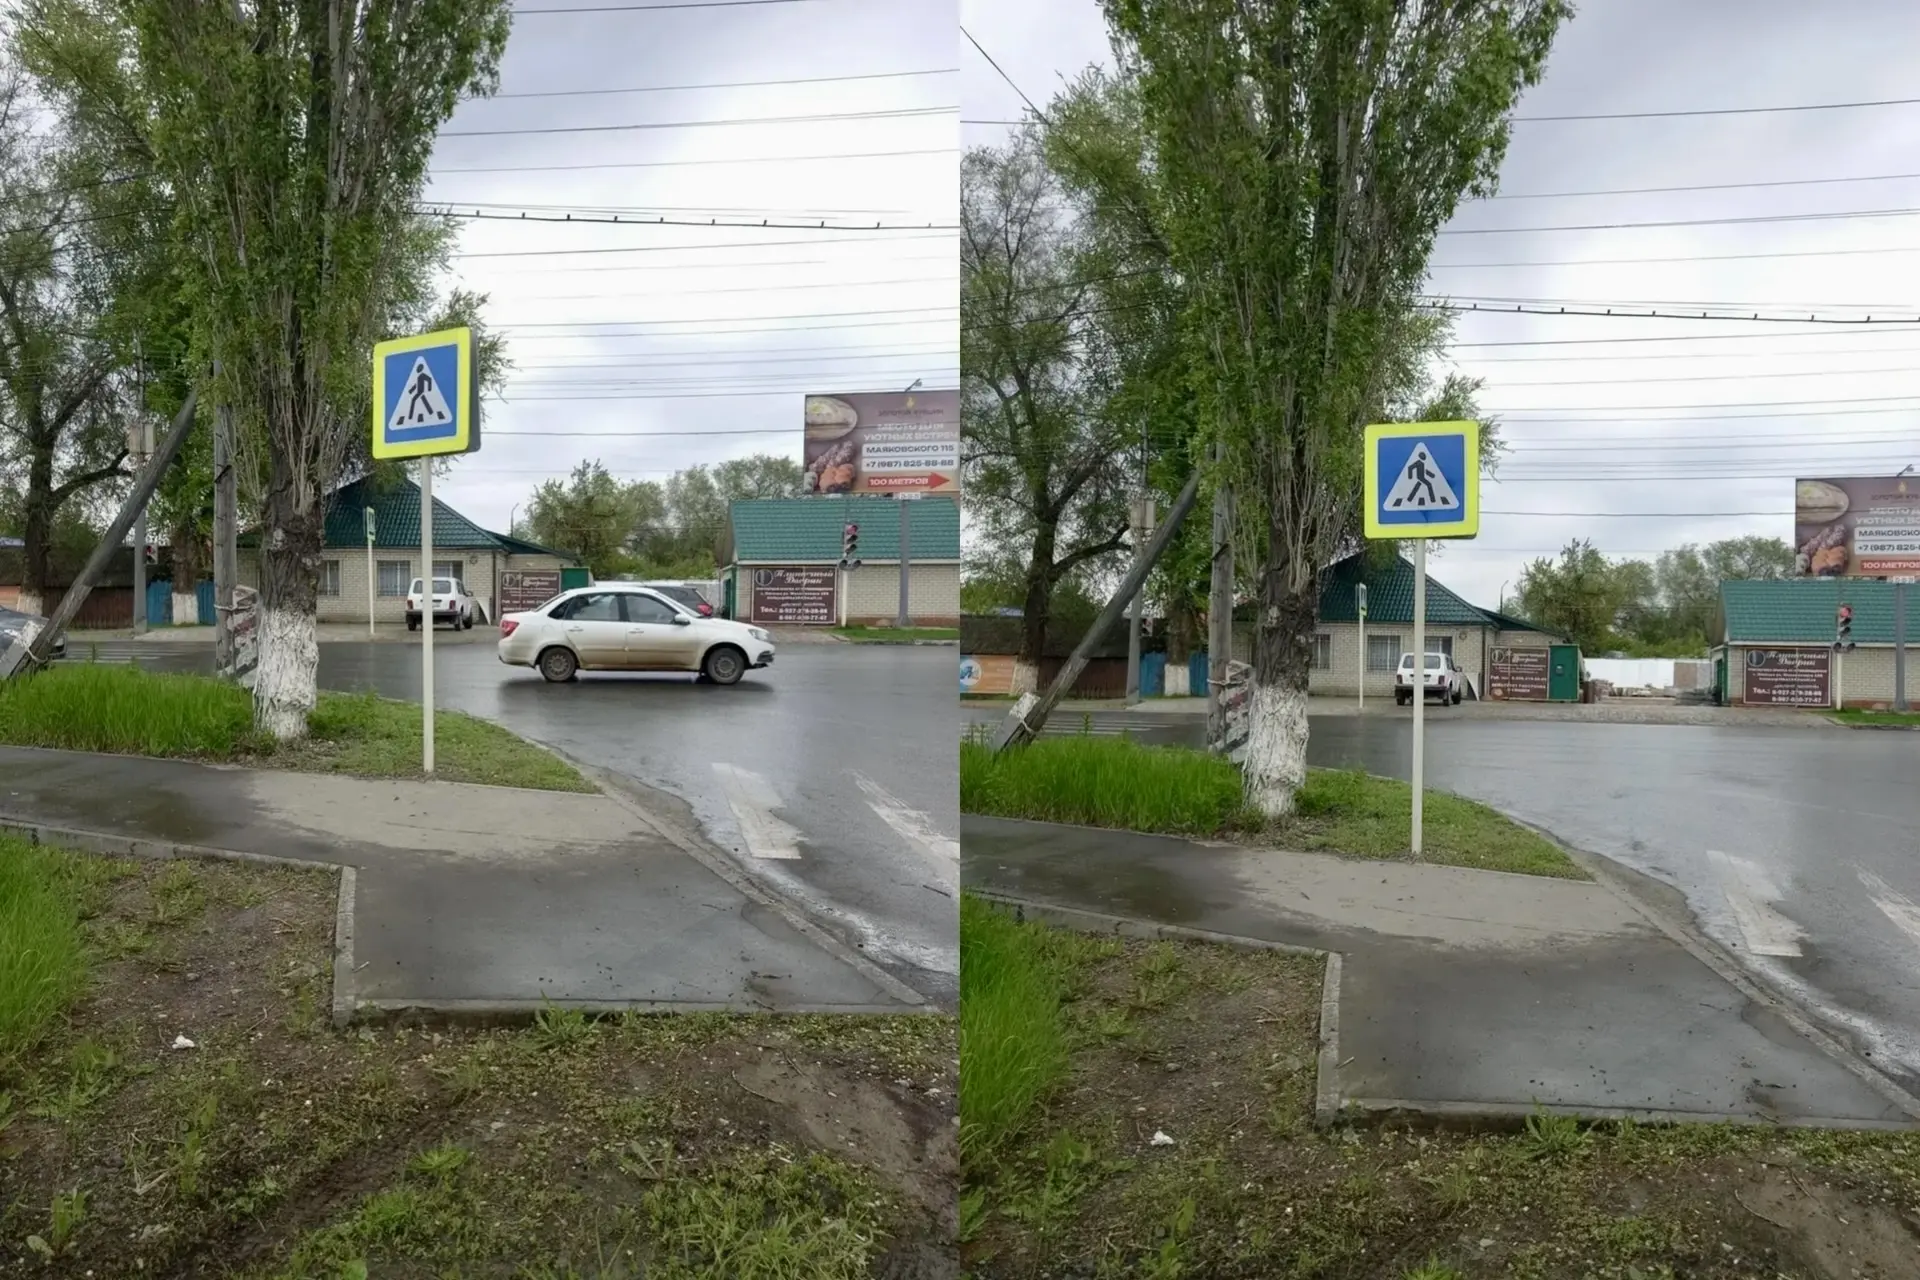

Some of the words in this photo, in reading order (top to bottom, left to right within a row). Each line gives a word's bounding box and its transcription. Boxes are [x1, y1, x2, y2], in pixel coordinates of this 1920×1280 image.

[864, 432, 913, 441] УЮТНЫХ
[869, 478, 886, 486] 100
[888, 477, 929, 485] МЕТРОВ
[1856, 517, 1903, 525] УЮТНЫХ
